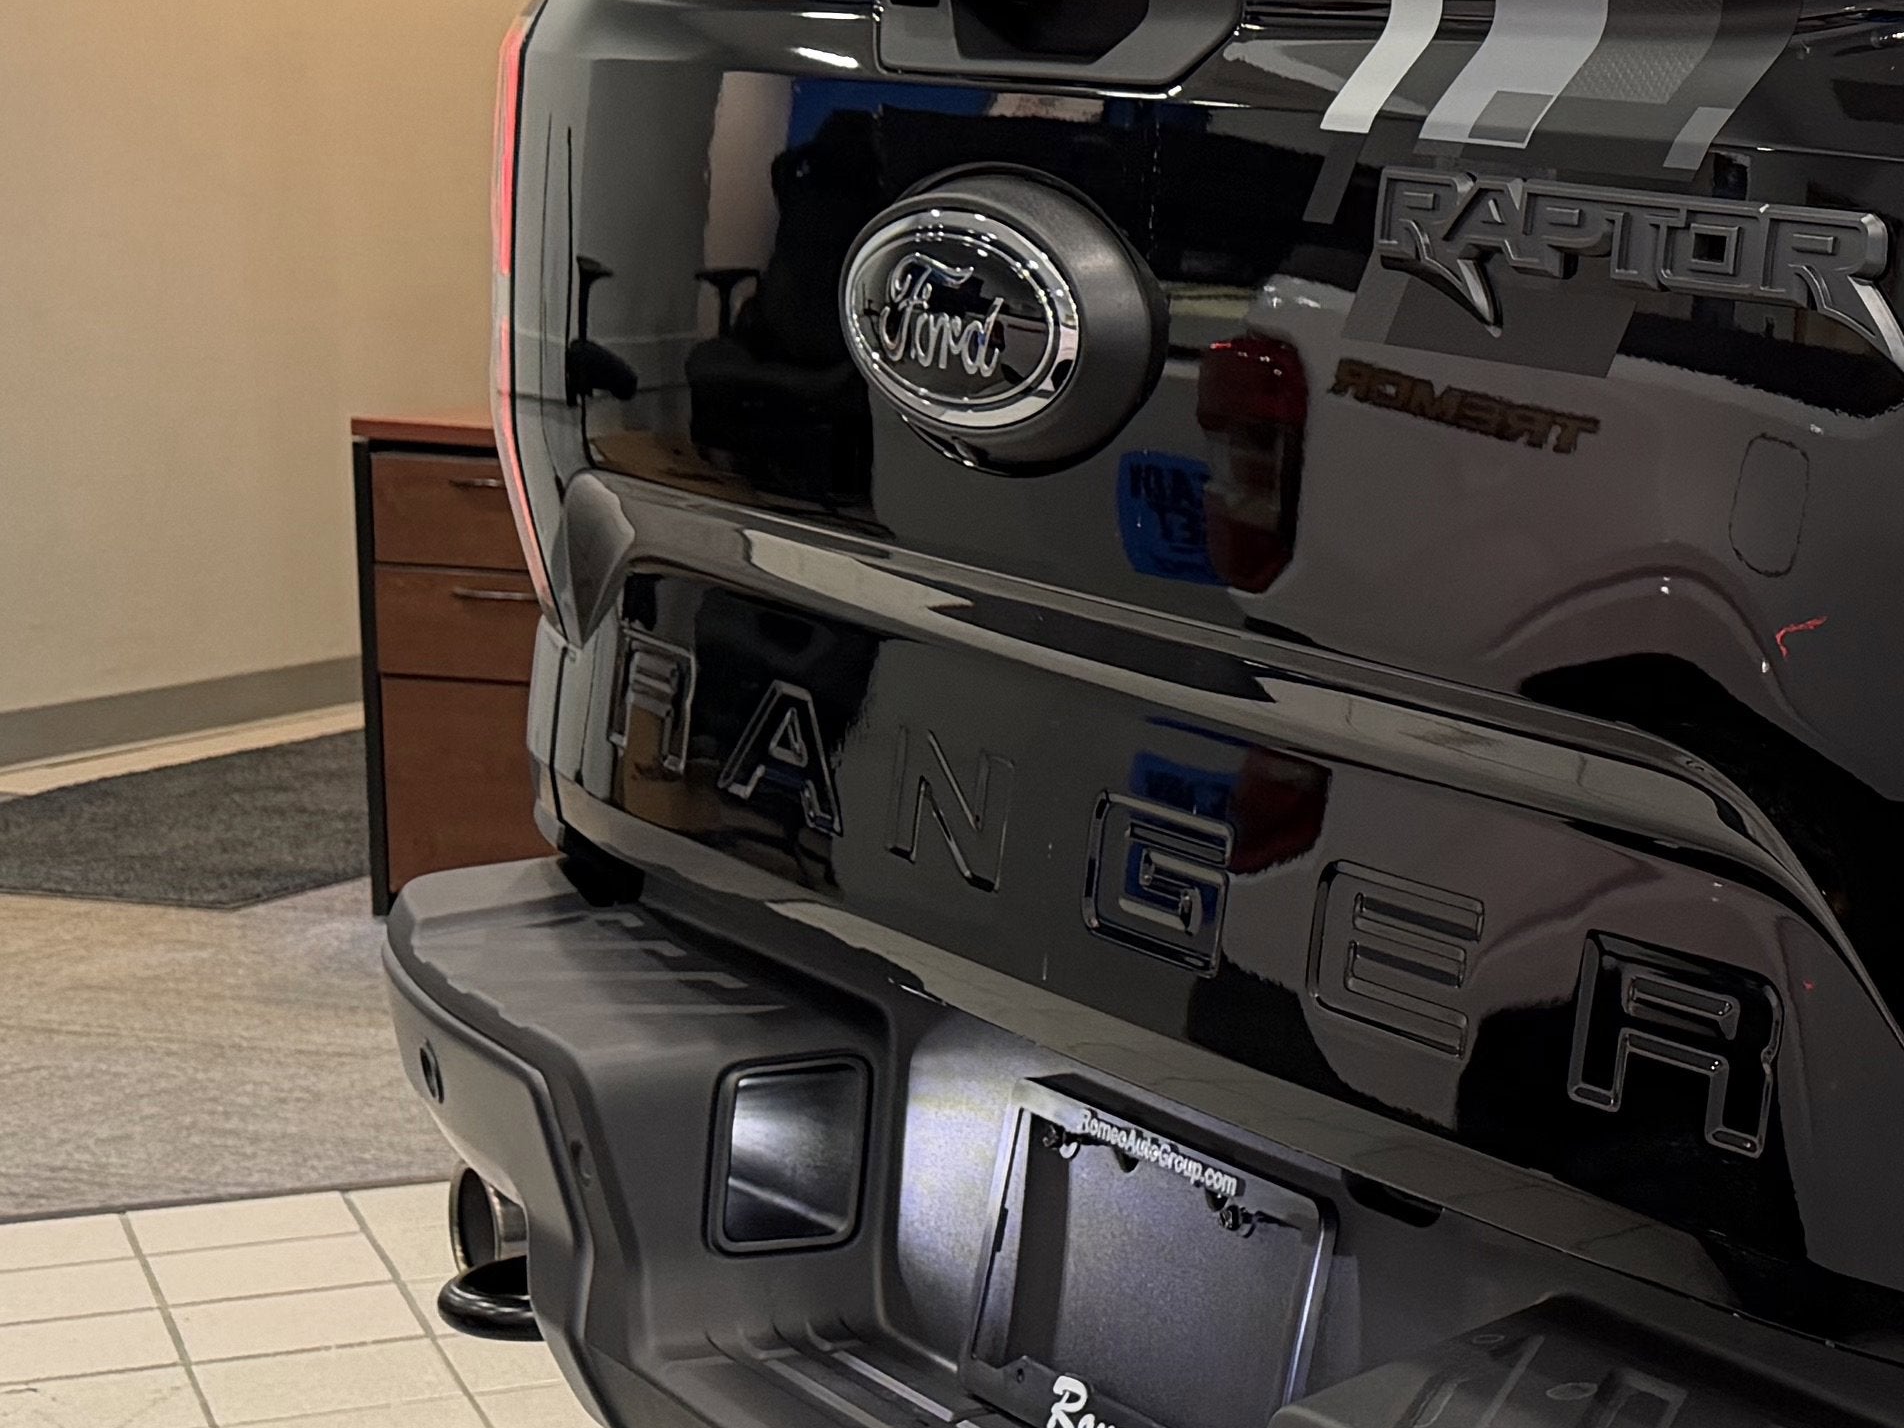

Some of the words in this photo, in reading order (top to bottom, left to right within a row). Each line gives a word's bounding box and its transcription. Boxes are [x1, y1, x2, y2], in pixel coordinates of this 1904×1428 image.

[875, 255, 1003, 378] Ford
[607, 624, 1782, 1158] RANGER
[1078, 1109, 1238, 1196] RomeoAutoGroup.com
